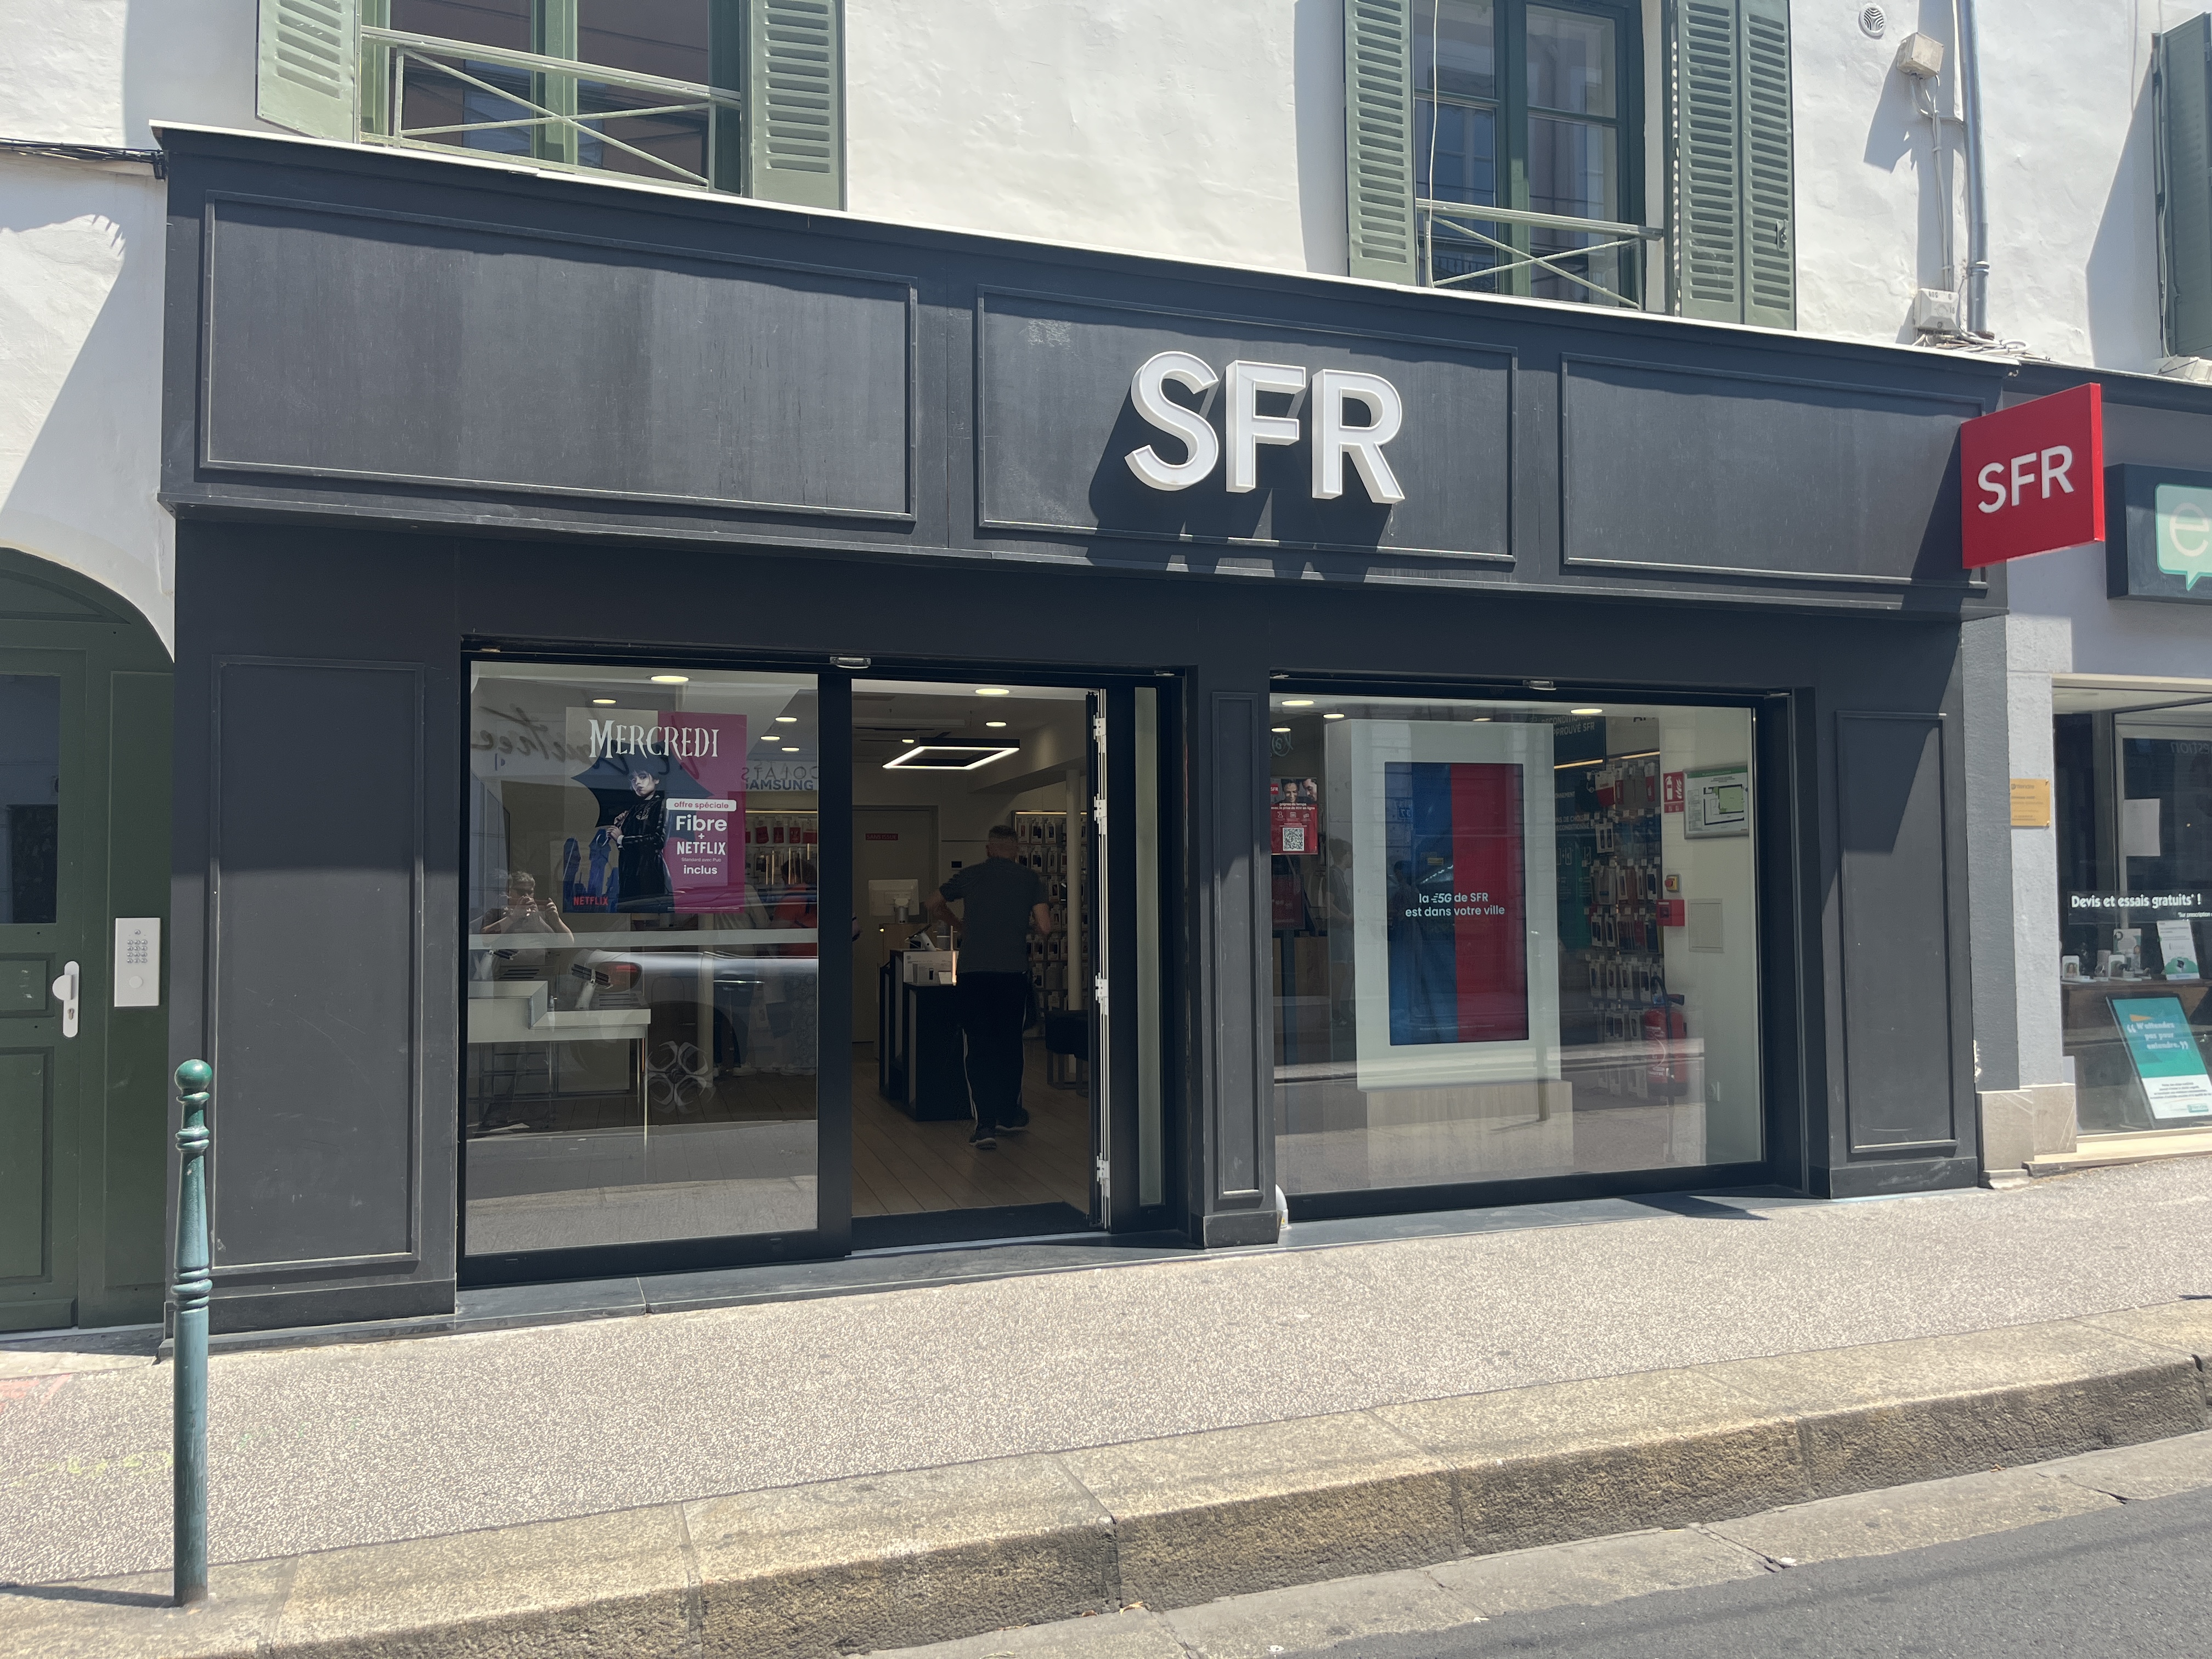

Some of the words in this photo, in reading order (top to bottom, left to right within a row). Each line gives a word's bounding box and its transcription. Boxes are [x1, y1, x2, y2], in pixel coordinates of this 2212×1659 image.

[1125, 351, 1405, 504] SFR
[1978, 445, 2074, 514] SFR
[1583, 721, 1595, 732] SFR
[589, 720, 720, 759] MERCREDI
[676, 814, 727, 832] Fibre
[676, 842, 726, 855] NETFLIX
[684, 865, 718, 874] inclus
[573, 896, 608, 906] NETFLIX
[1419, 893, 1429, 904] la
[1454, 893, 1468, 903] de
[1470, 893, 1488, 902] SFR
[2071, 895, 2100, 908] Devis
[2103, 895, 2115, 907] et
[2118, 894, 2149, 907] essais
[1405, 907, 1422, 917] est
[1424, 906, 1451, 916] dans
[1454, 907, 1481, 916] votre
[1483, 905, 1505, 915] ville
